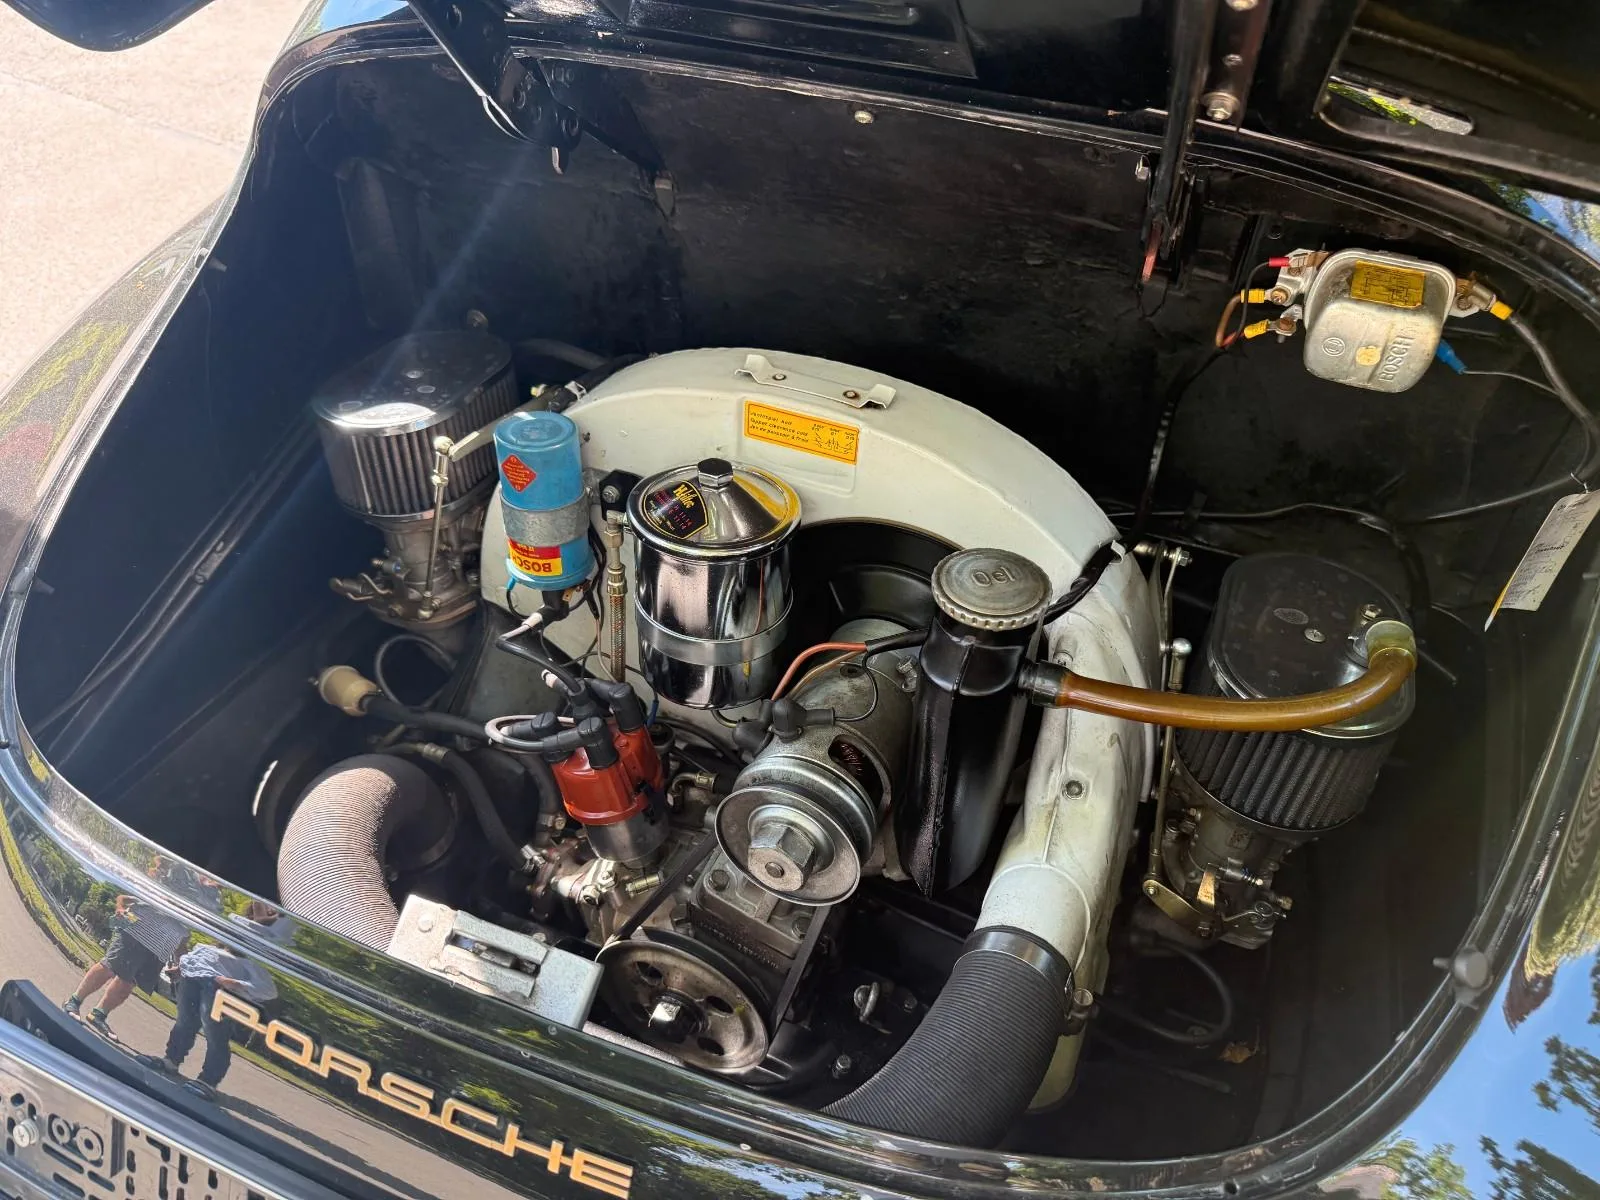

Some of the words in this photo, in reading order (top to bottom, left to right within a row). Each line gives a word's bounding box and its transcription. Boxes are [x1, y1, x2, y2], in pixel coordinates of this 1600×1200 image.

[1379, 335, 1416, 382] BOSCH
[512, 554, 553, 574] BOSCH
[971, 566, 1016, 587] Oel
[210, 988, 634, 1199] PORSCHE
